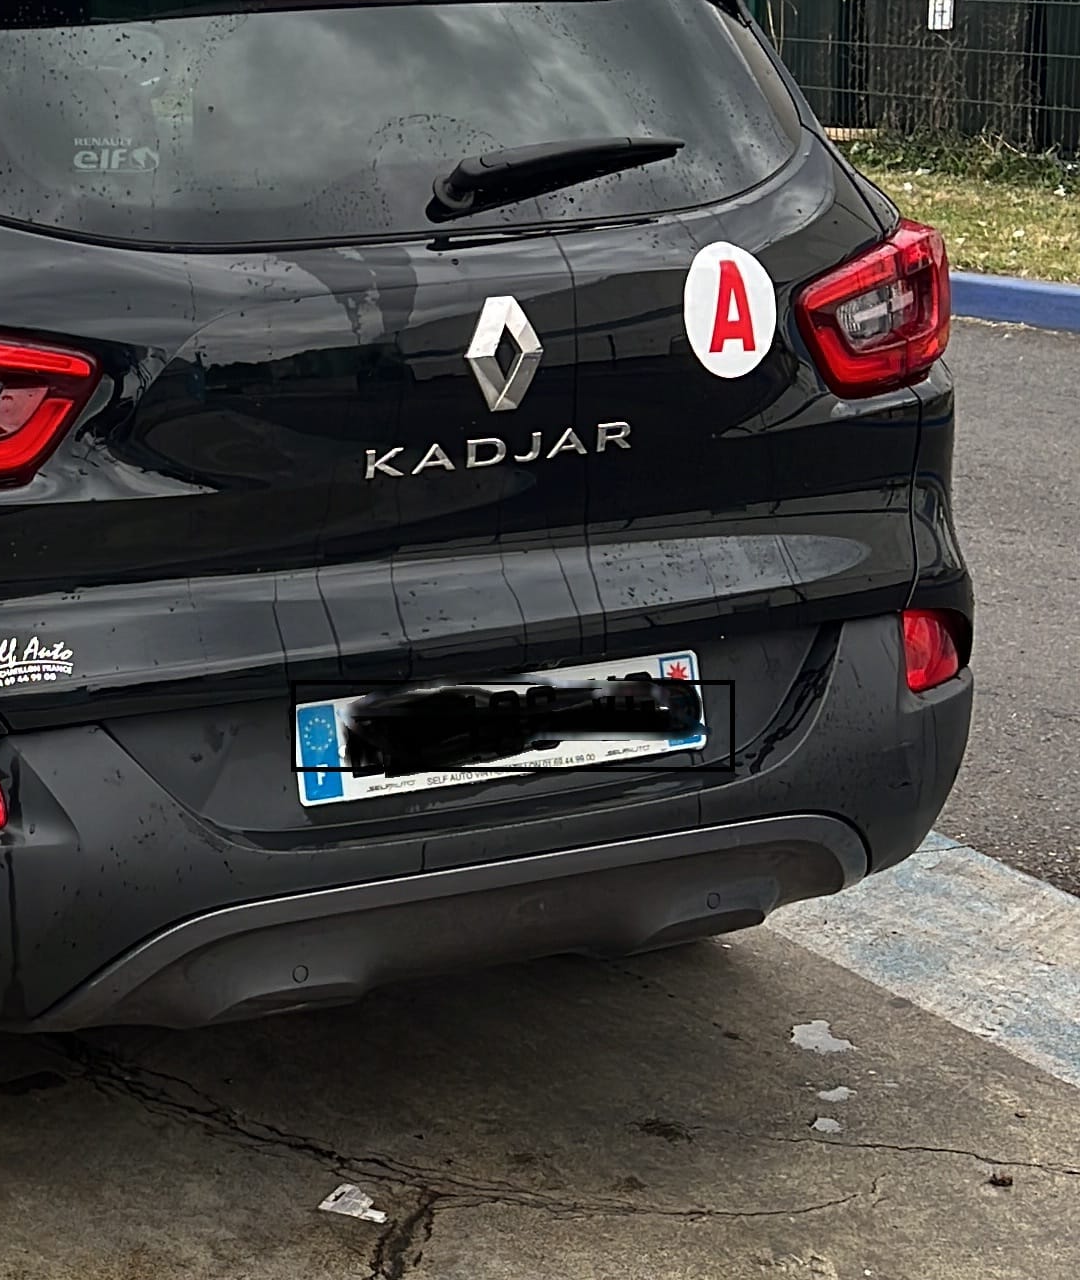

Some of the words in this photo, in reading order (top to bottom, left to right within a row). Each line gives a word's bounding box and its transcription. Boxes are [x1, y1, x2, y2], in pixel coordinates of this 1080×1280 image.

[74, 137, 132, 146] RENAULT
[73, 148, 128, 169] elf
[708, 259, 757, 354] A
[364, 421, 633, 480] KADJAR
[22, 636, 73, 661] Auto
[316, 763, 328, 785] F
[426, 775, 448, 786] SELF
